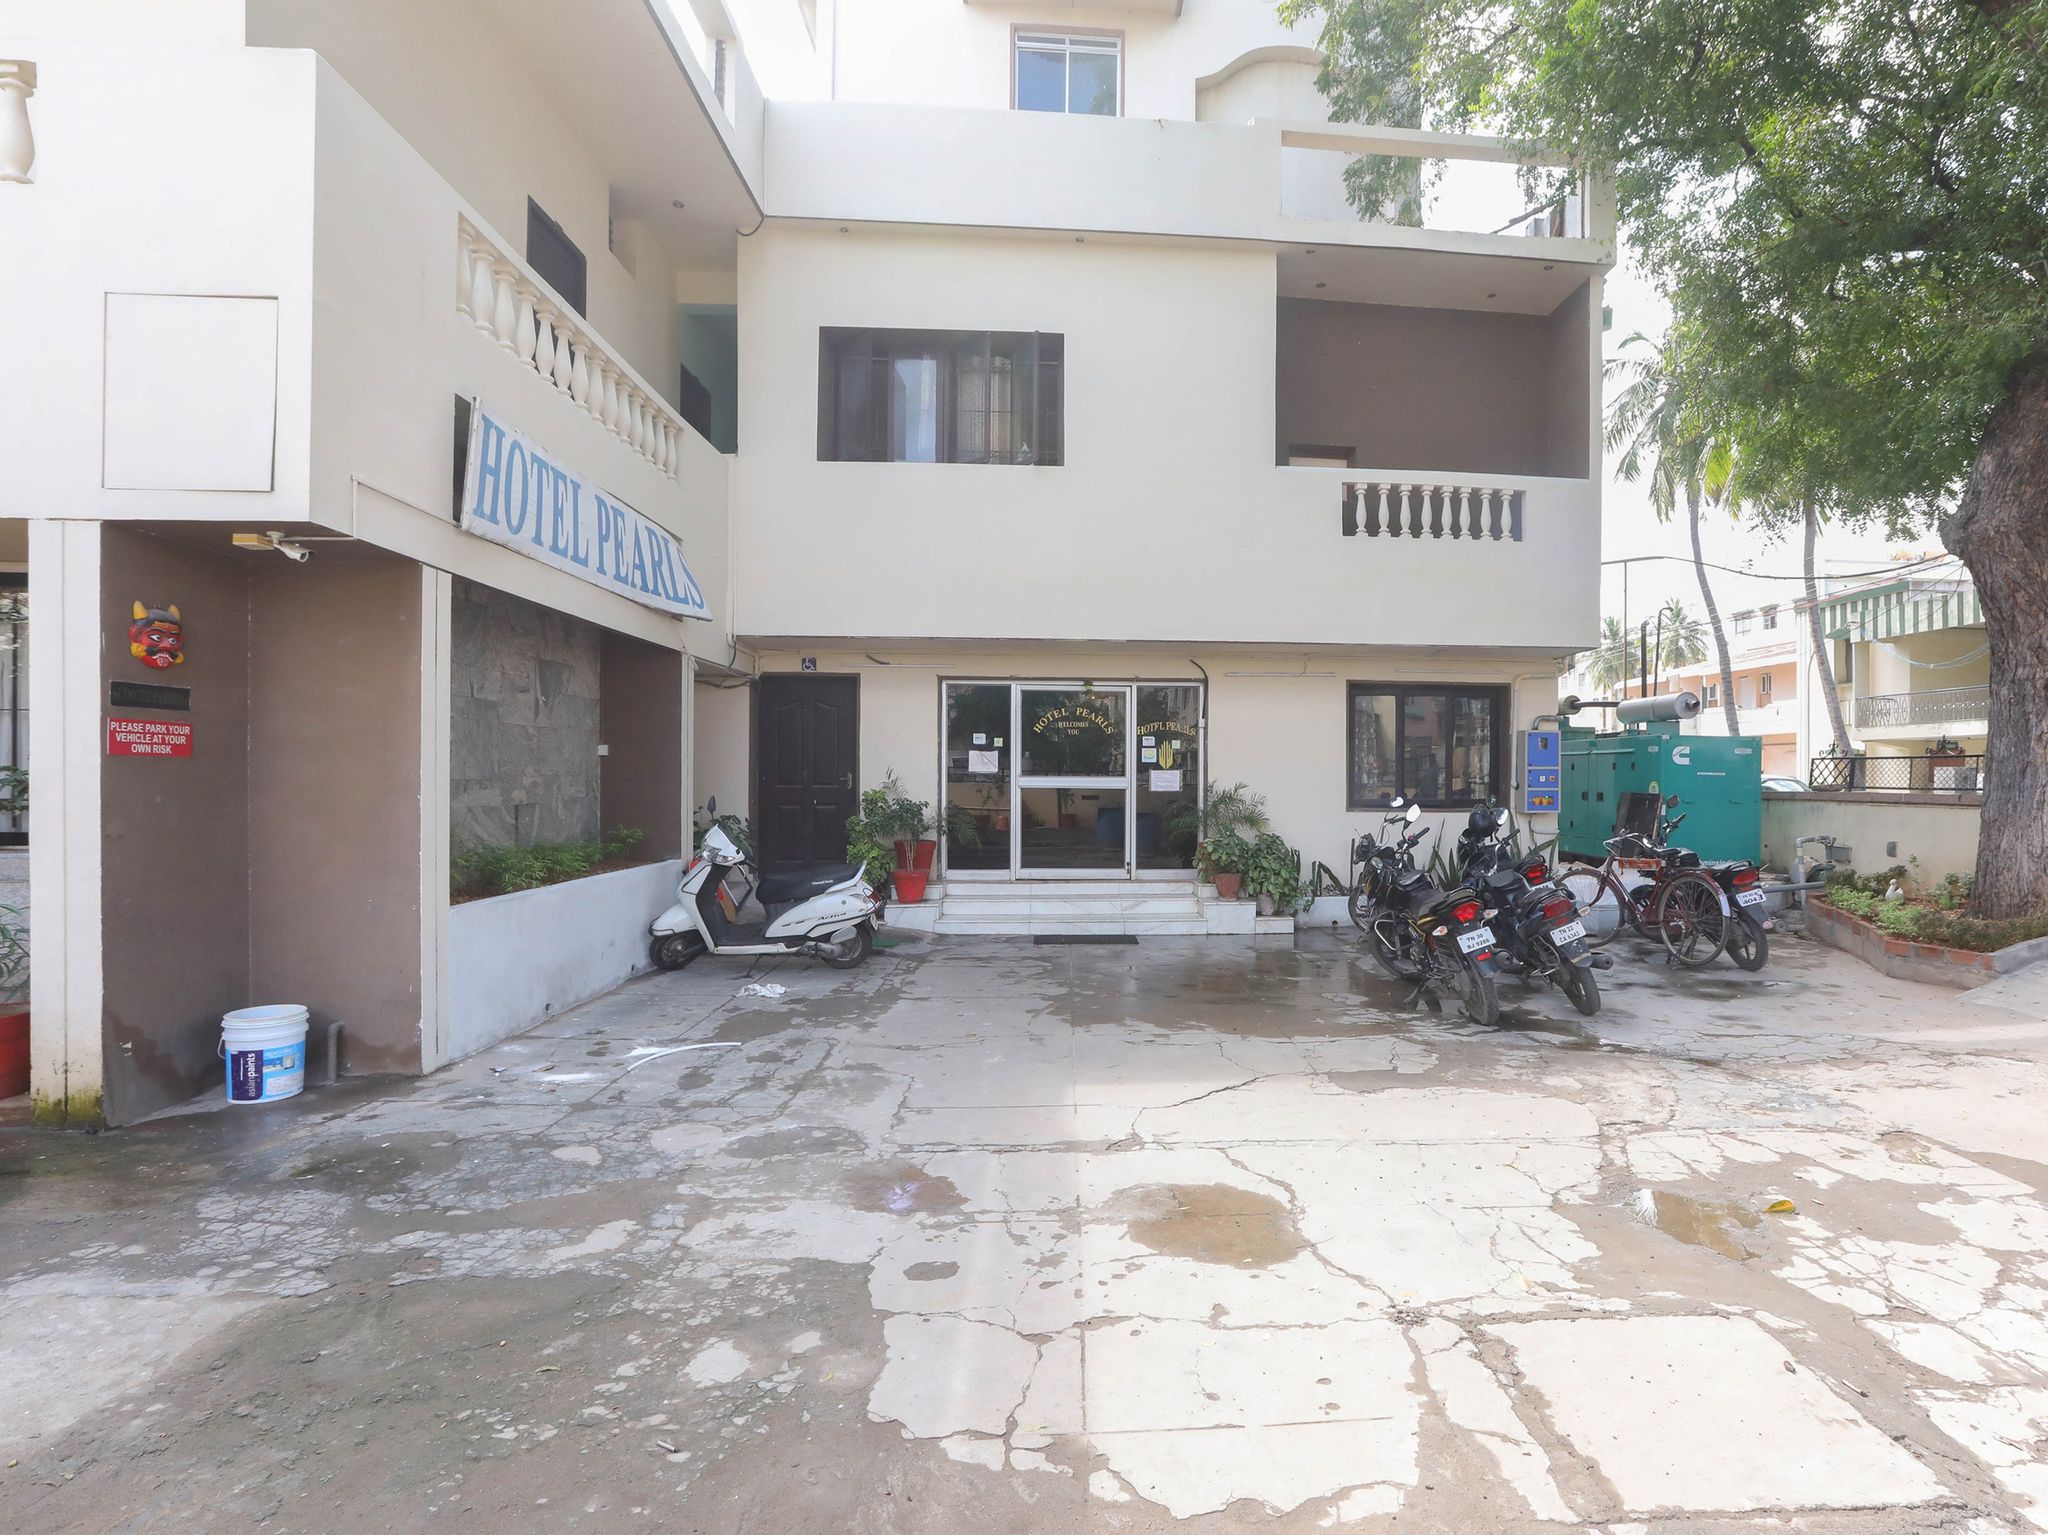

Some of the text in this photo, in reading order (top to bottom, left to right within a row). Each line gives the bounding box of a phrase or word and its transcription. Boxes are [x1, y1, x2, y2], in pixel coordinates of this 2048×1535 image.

[473, 413, 705, 609] HOTEL PEARLS
[110, 721, 190, 735] PLEASE PARK YOUR
[1032, 707, 1114, 735] HOTEL PEARLS
[1137, 721, 1165, 735] HOTEL
[115, 733, 186, 744] VEHICLE AT YOUR
[131, 744, 172, 754] OWN RISK
